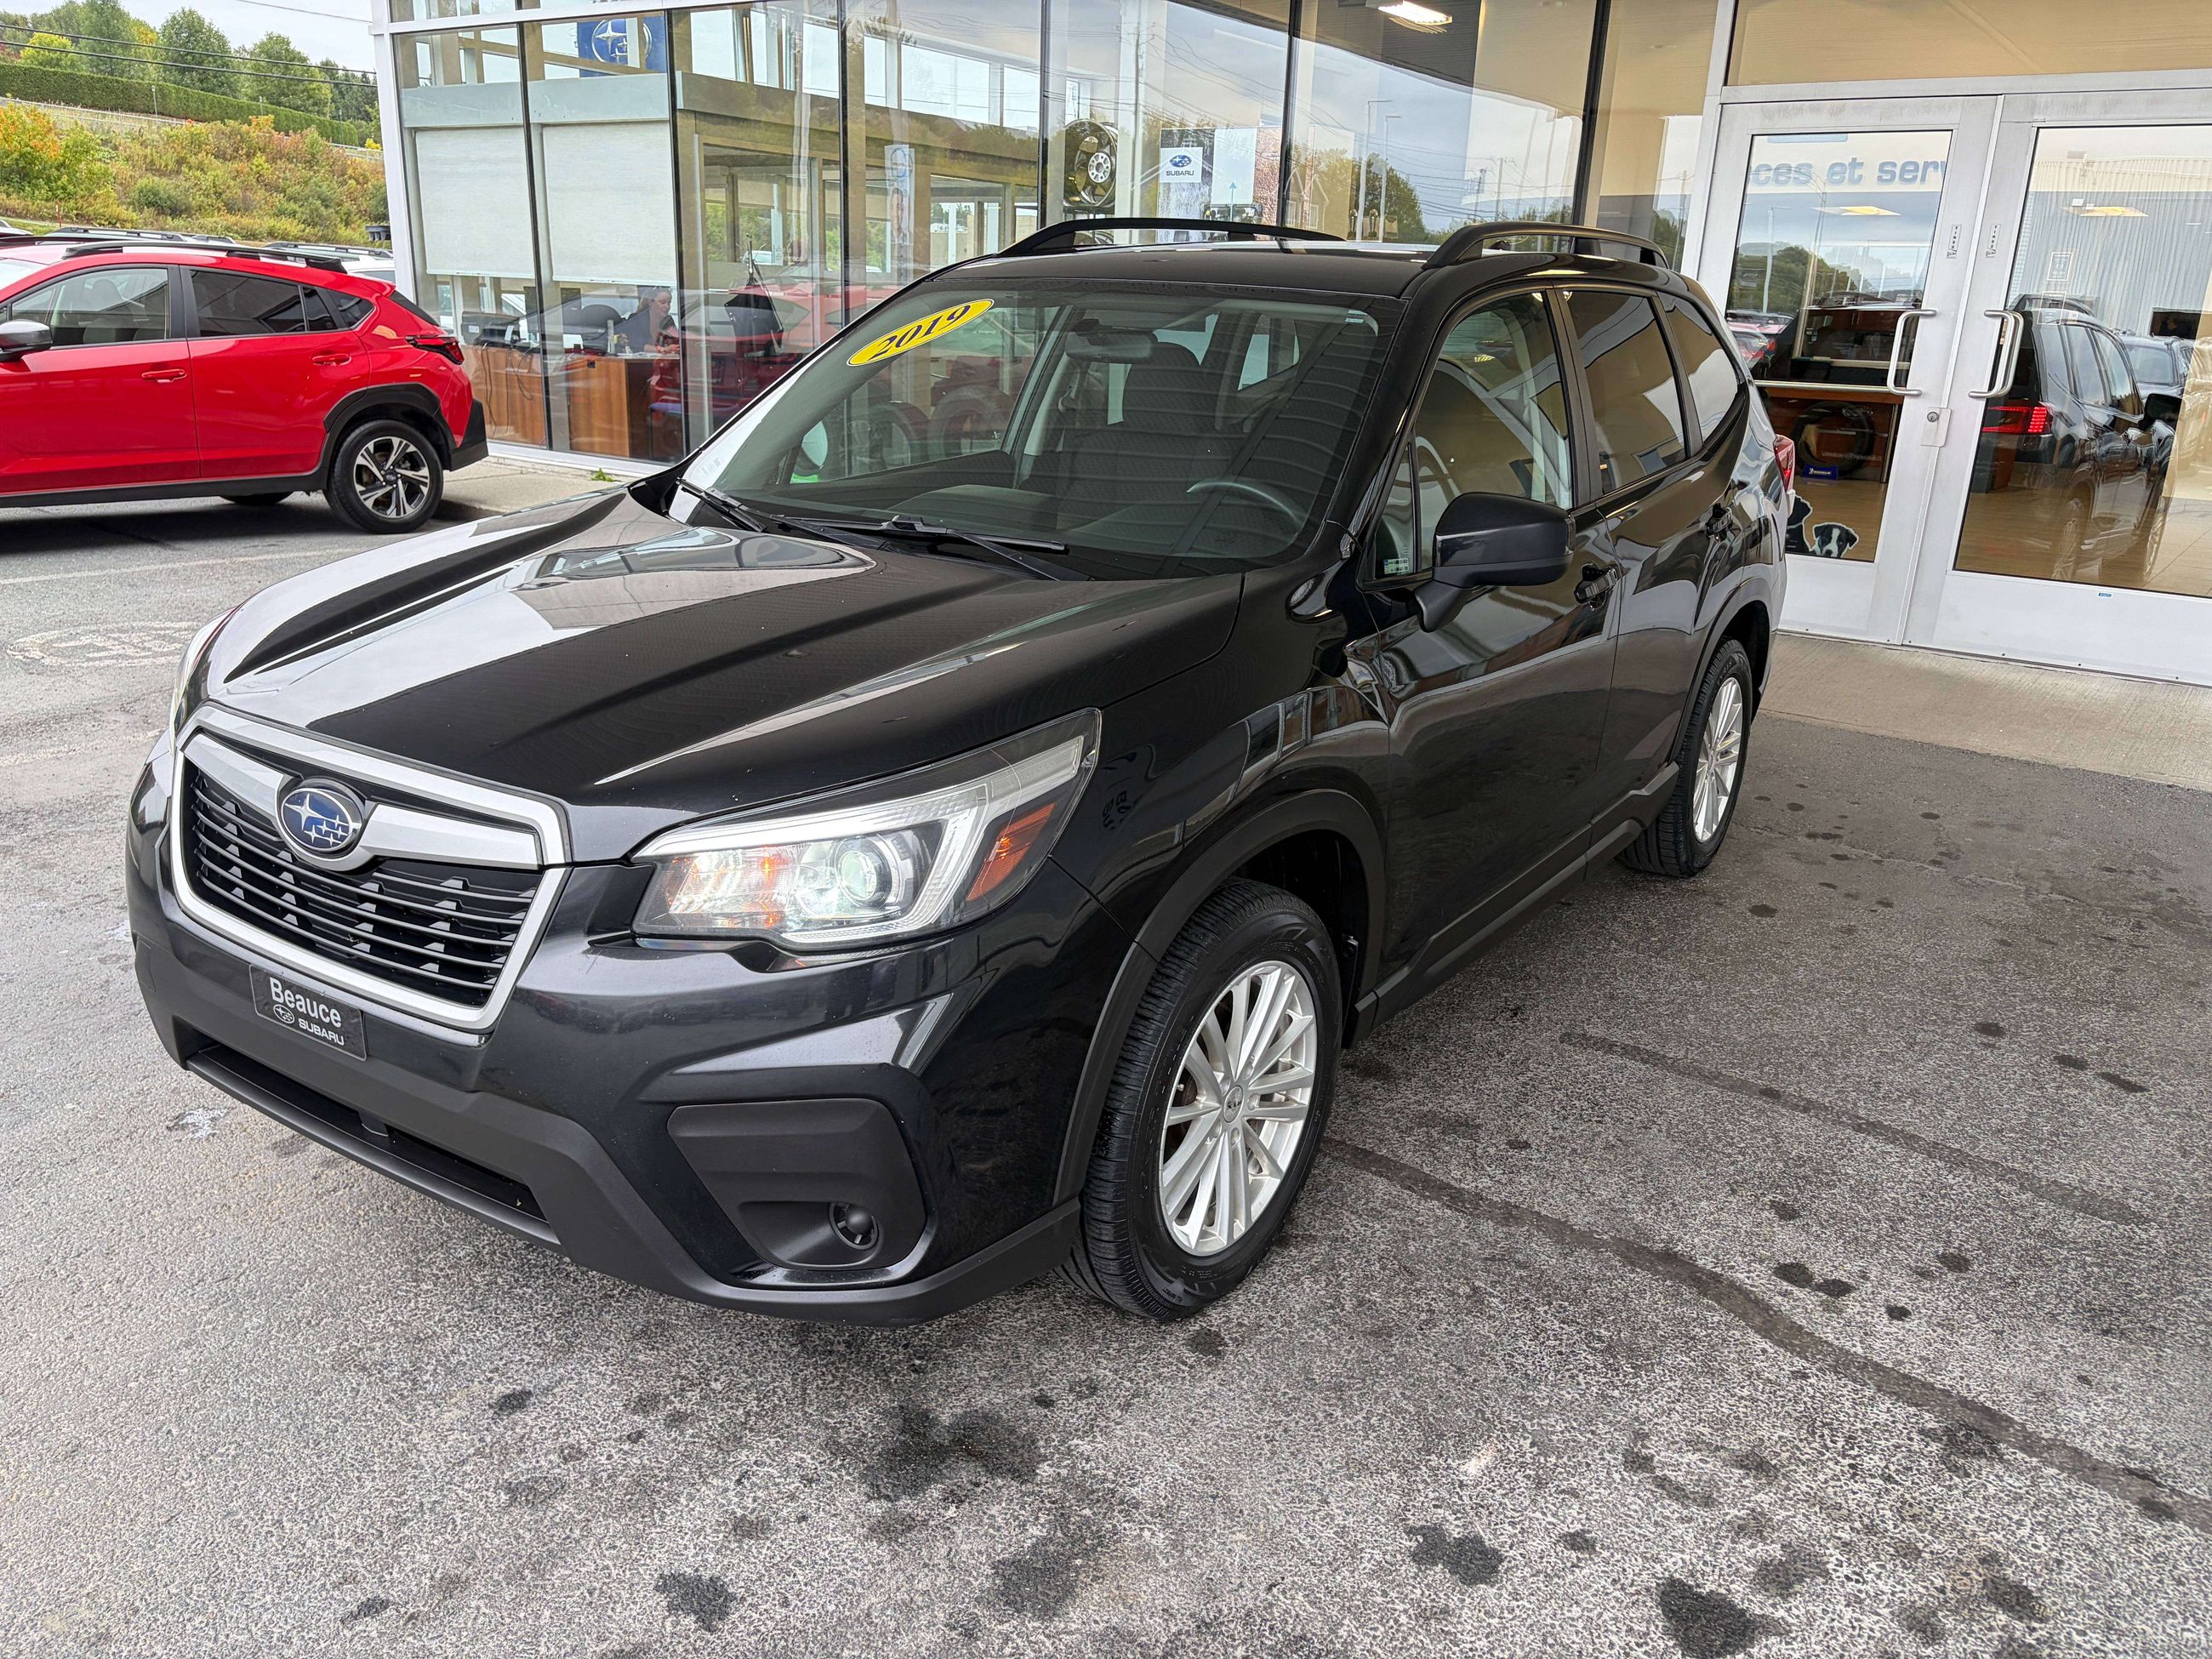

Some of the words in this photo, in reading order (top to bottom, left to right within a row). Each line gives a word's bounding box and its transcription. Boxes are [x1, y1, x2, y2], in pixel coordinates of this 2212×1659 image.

[1749, 162, 1814, 186] ces
[1827, 157, 1865, 185] et
[868, 305, 972, 361] 2019
[270, 976, 342, 1029] Beauce
[298, 1018, 345, 1046] SUBARU
